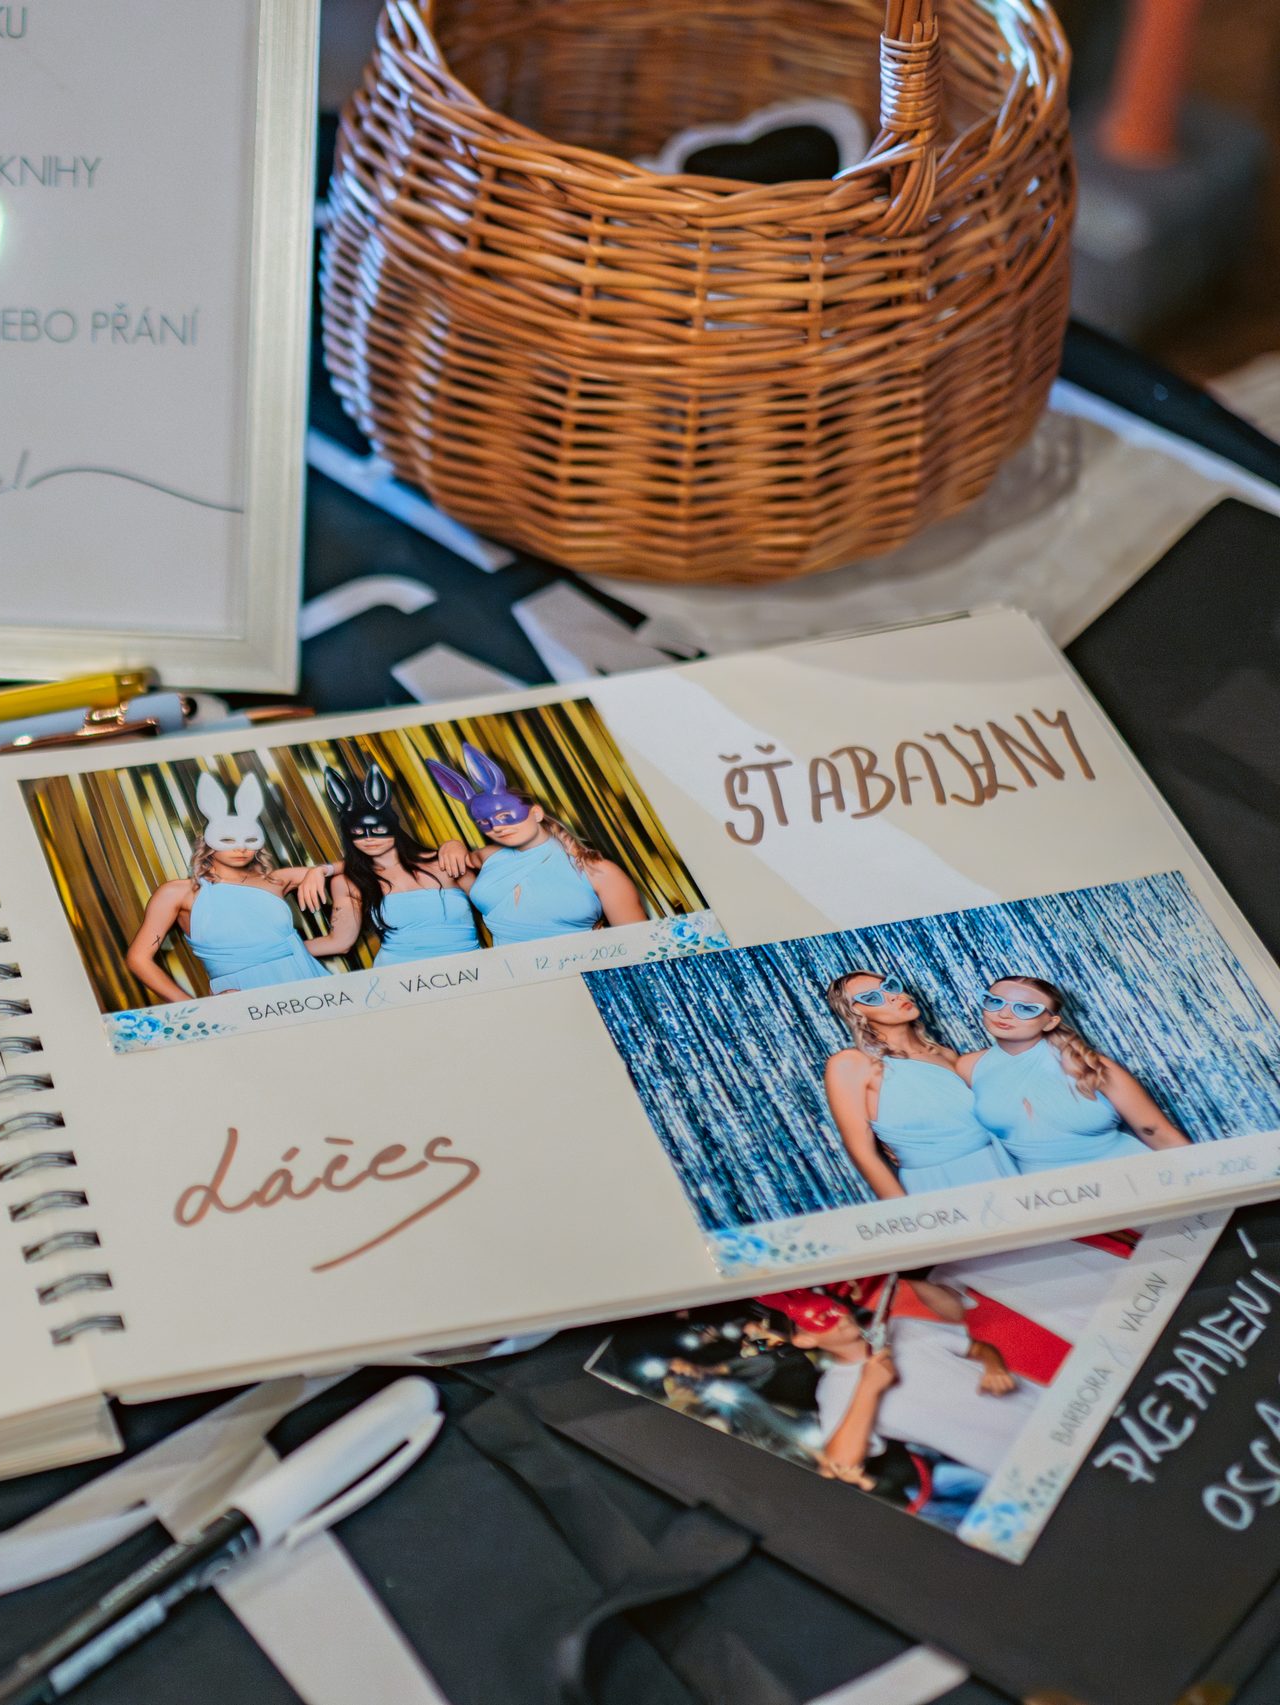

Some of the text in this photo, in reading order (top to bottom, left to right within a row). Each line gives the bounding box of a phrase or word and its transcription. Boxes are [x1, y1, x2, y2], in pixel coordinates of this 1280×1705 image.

[91, 303, 199, 346] PŘÁNÍ
[248, 991, 353, 1021] BARBORA
[400, 966, 480, 994] VÁCLAV
[590, 943, 627, 961] 2026
[855, 1207, 968, 1242] BARBORA
[1050, 1366, 1113, 1447] BARBORA
